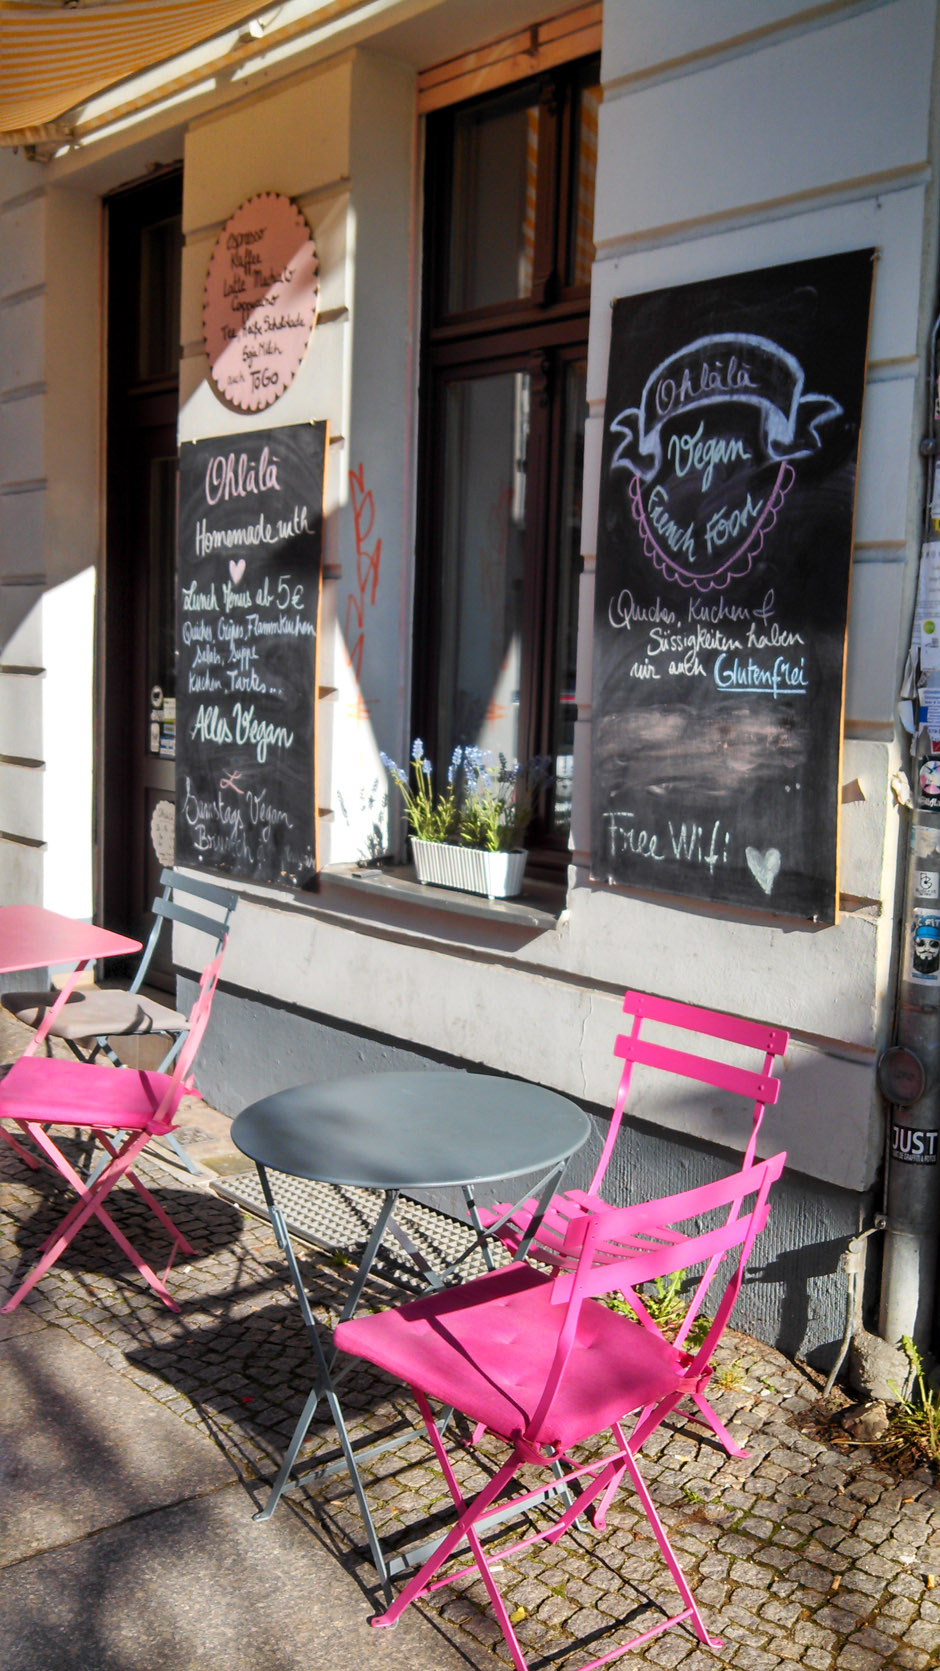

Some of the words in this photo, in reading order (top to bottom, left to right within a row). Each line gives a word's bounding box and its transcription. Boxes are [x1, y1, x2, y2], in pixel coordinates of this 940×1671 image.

[224, 273, 247, 297] Latte
[668, 419, 752, 492] Vegan
[196, 513, 278, 557] Homemade
[277, 505, 315, 539] with
[647, 485, 697, 562] French
[183, 580, 219, 612] Lunch
[255, 576, 275, 607] ab
[688, 595, 750, 624] Kuchen
[647, 624, 743, 664] Süssigkeiten
[746, 622, 805, 648] haben
[630, 659, 661, 680] wir
[669, 657, 707, 677] auch
[713, 652, 809, 699] Glutenfrei
[191, 704, 232, 744] Alles
[232, 702, 294, 763] Vegan
[246, 788, 293, 842] Vegan
[602, 811, 665, 861] Free
[893, 1126, 938, 1155] JUST
